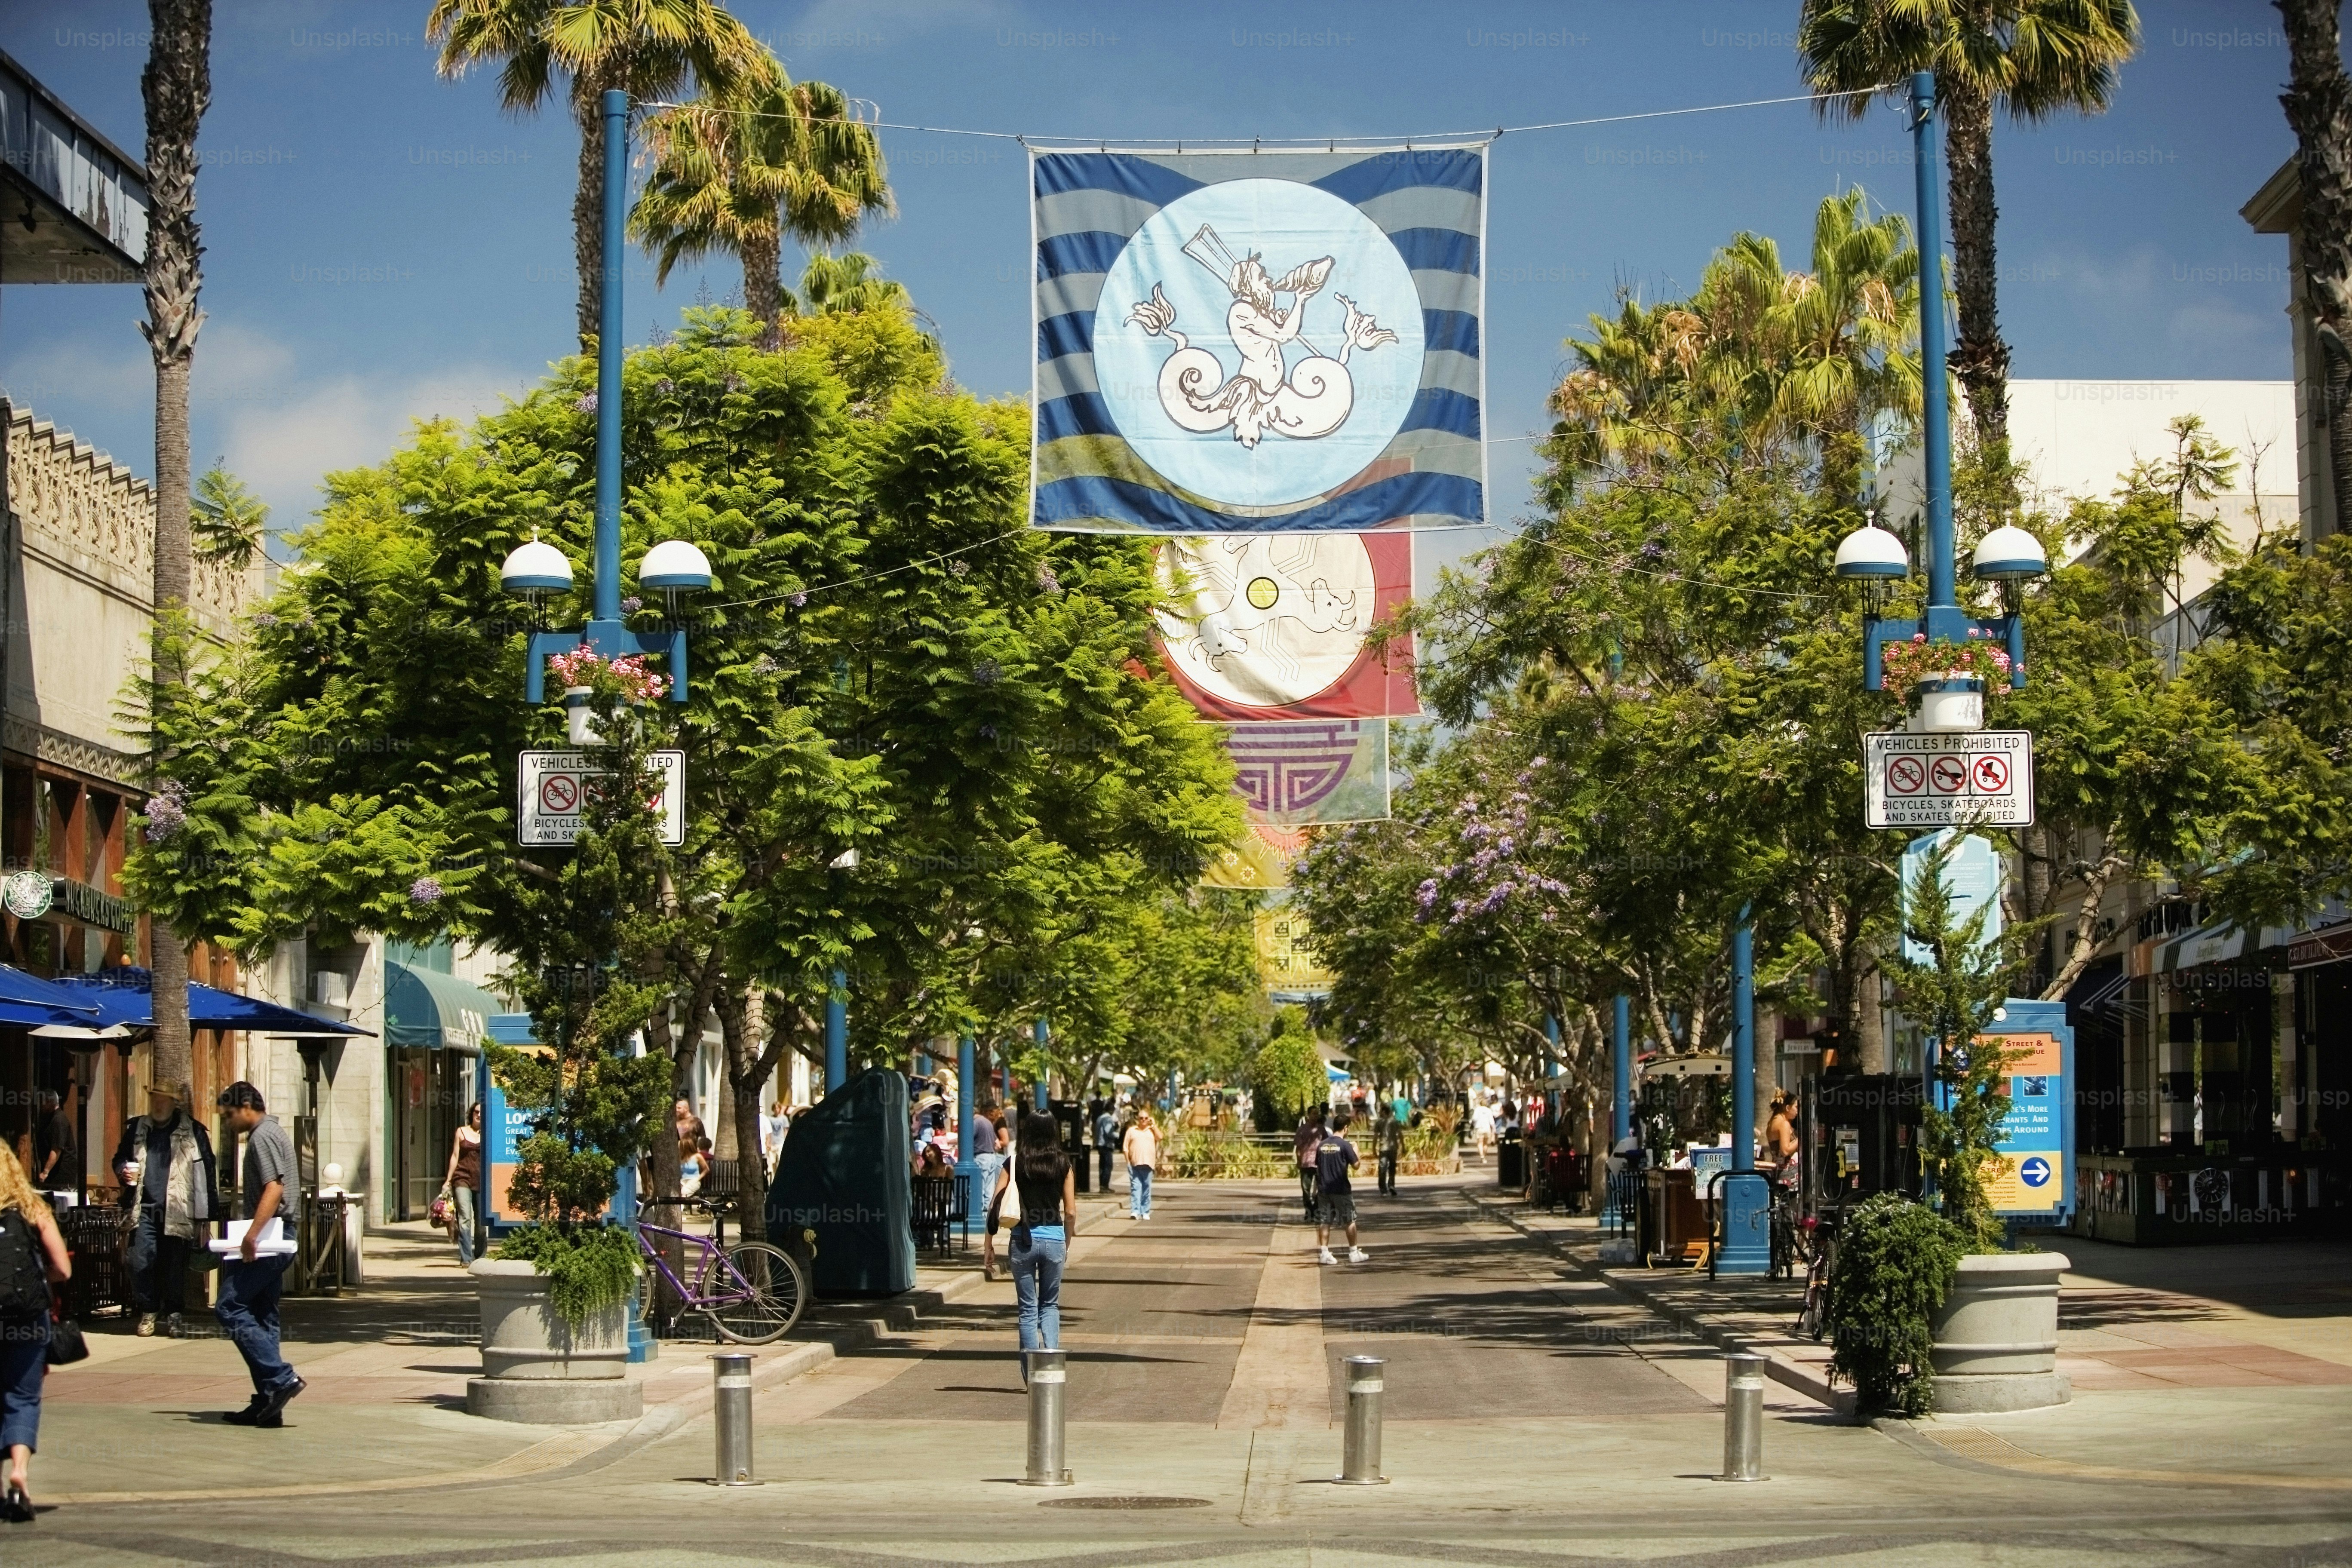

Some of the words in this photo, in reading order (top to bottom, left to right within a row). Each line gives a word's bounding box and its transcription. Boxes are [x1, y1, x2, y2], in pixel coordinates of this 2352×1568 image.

[1876, 739, 1938, 750] VEHICLES
[1944, 738, 2019, 749] PROHIBITED
[531, 758, 592, 769] VEHICLES
[1882, 801, 1935, 810] BICYCLES,
[1941, 799, 2016, 809] SKATEBOARDS
[1885, 813, 1905, 822] AND
[1910, 812, 1950, 821] SKATES
[1955, 811, 2014, 820] PROHIBITED
[535, 819, 587, 828] BICYCLES,
[537, 831, 557, 840] AND
